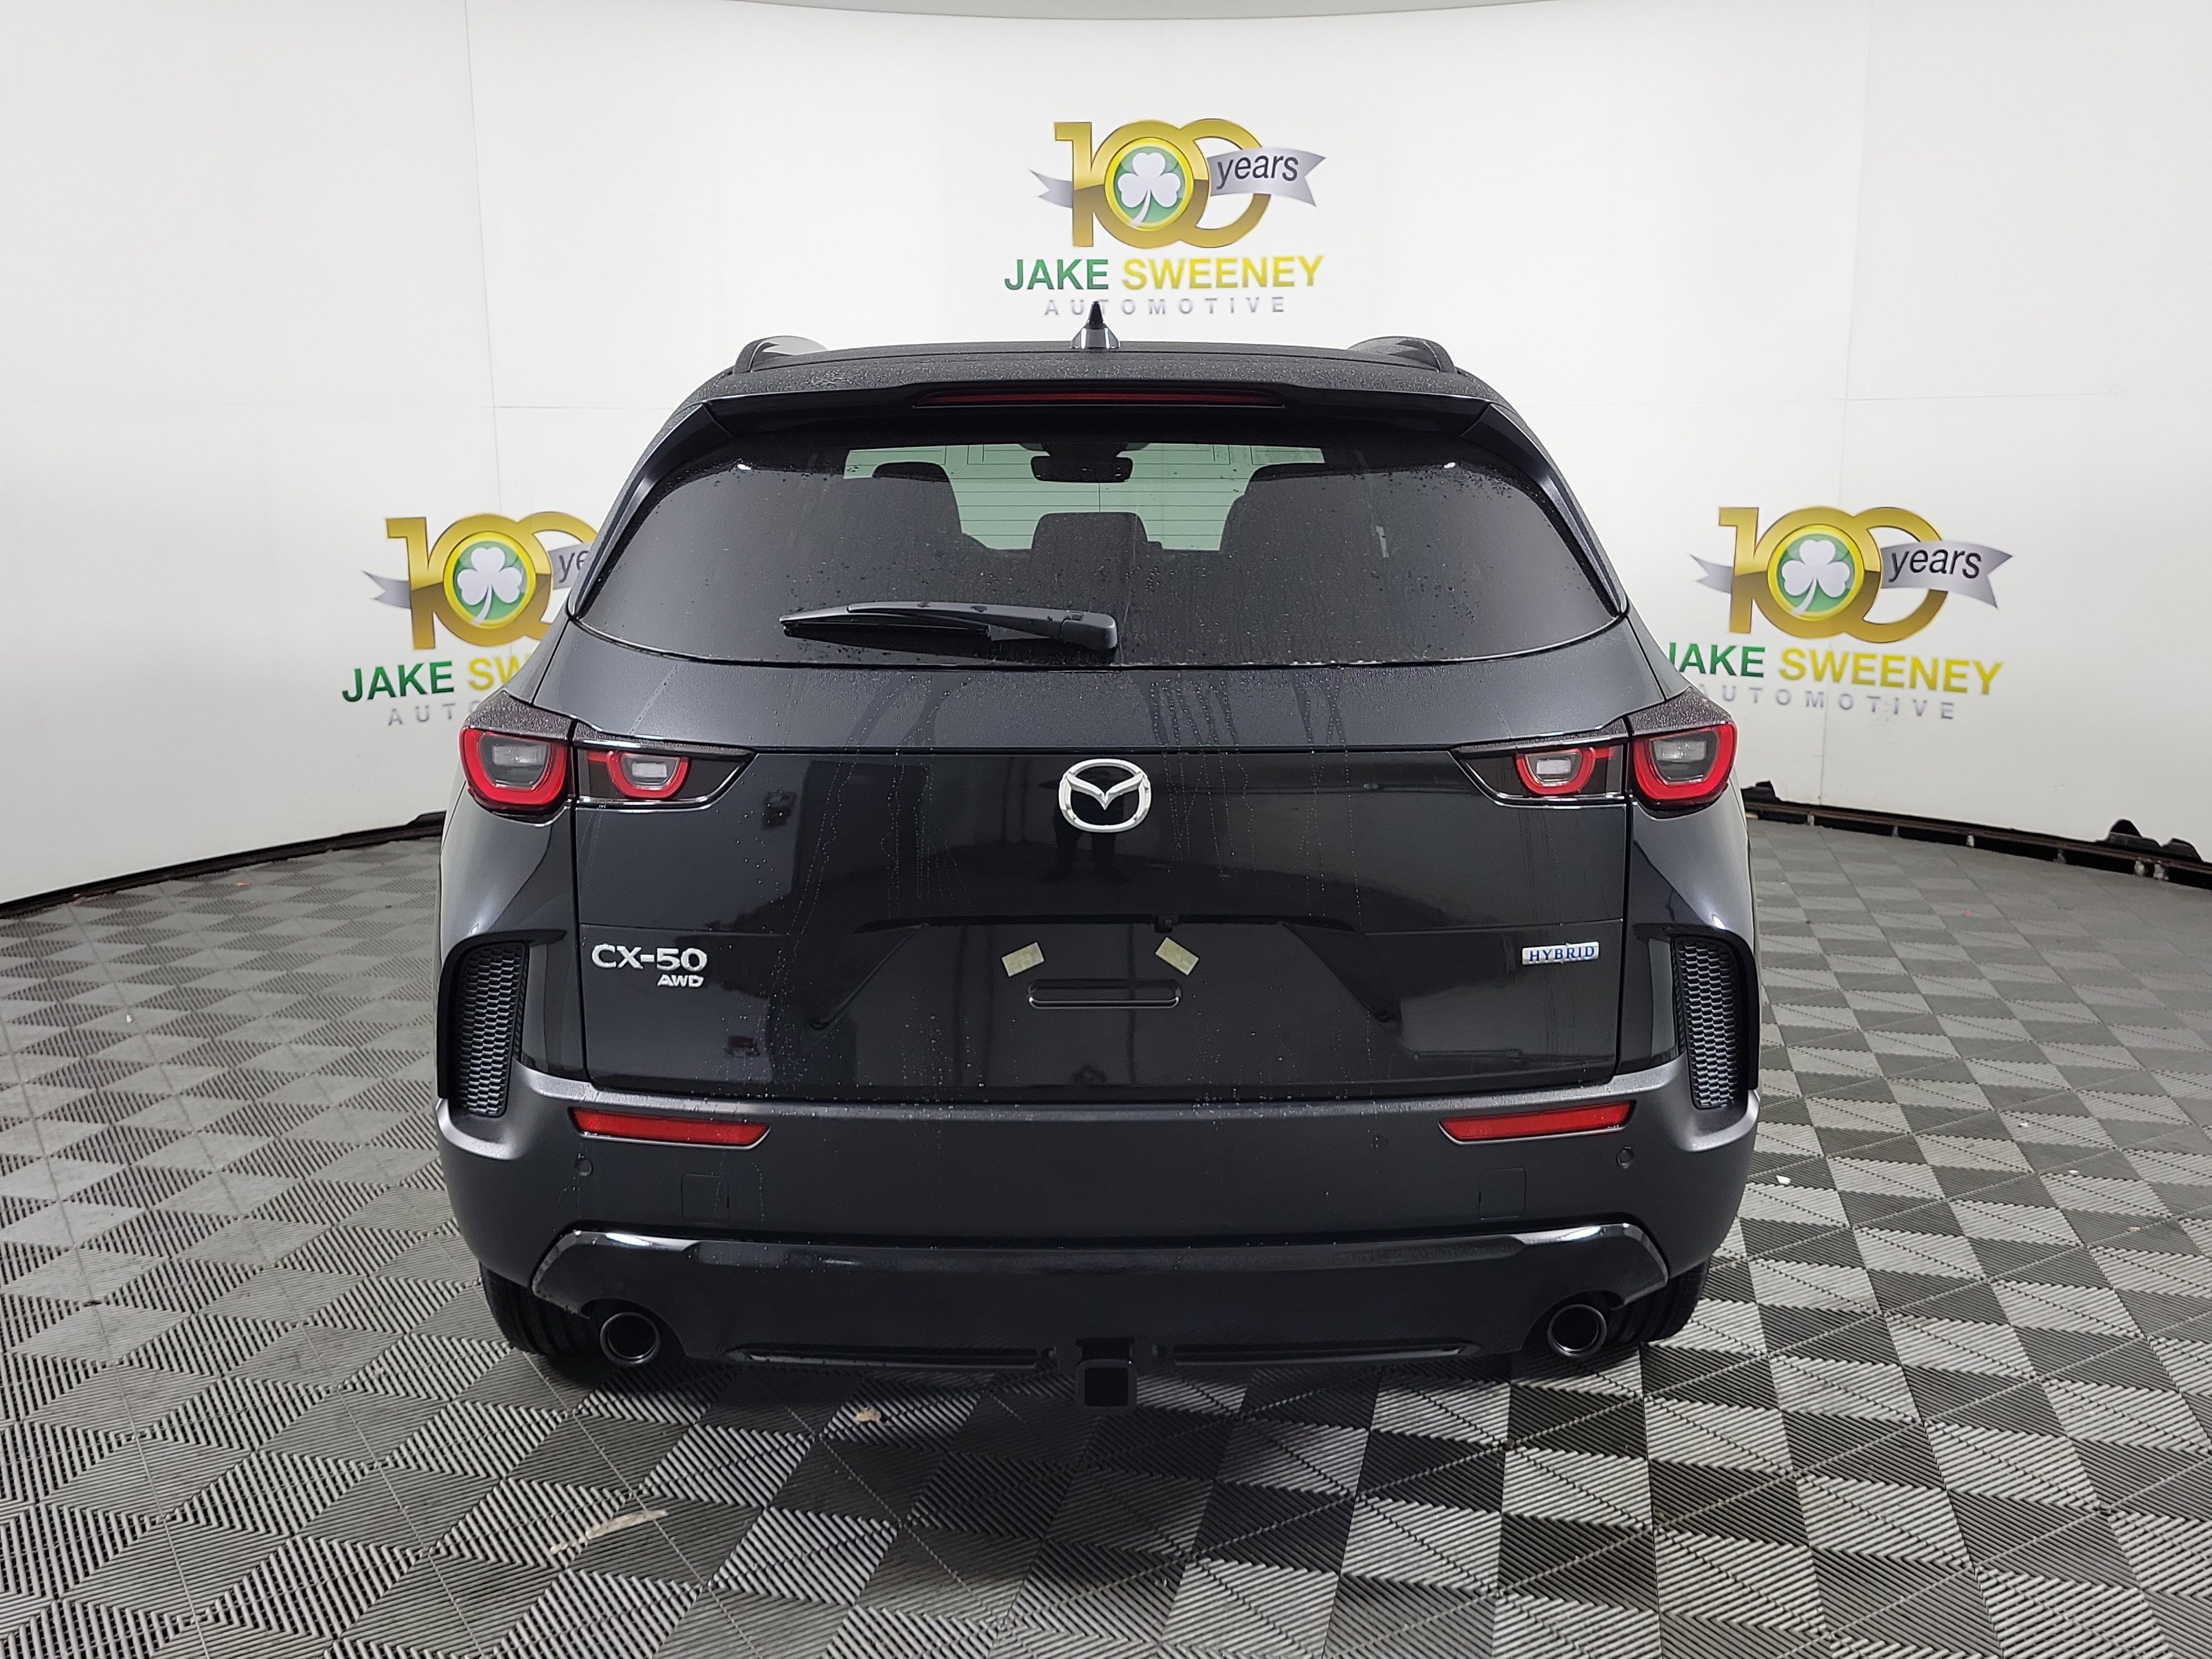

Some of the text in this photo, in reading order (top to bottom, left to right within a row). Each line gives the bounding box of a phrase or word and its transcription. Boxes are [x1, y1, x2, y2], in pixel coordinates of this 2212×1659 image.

[1054, 118, 1299, 249] 100 years
[1005, 255, 1324, 290] JAKE SWEENEY
[1045, 296, 1285, 316] AUTOMOTIVE
[1718, 505, 1982, 644] 100 years
[342, 661, 455, 703] JAKE
[1779, 648, 2002, 695] SWEENEY
[591, 943, 708, 972] CX-50
[1529, 945, 1595, 962] HYBRID
[657, 974, 704, 988] AWD
